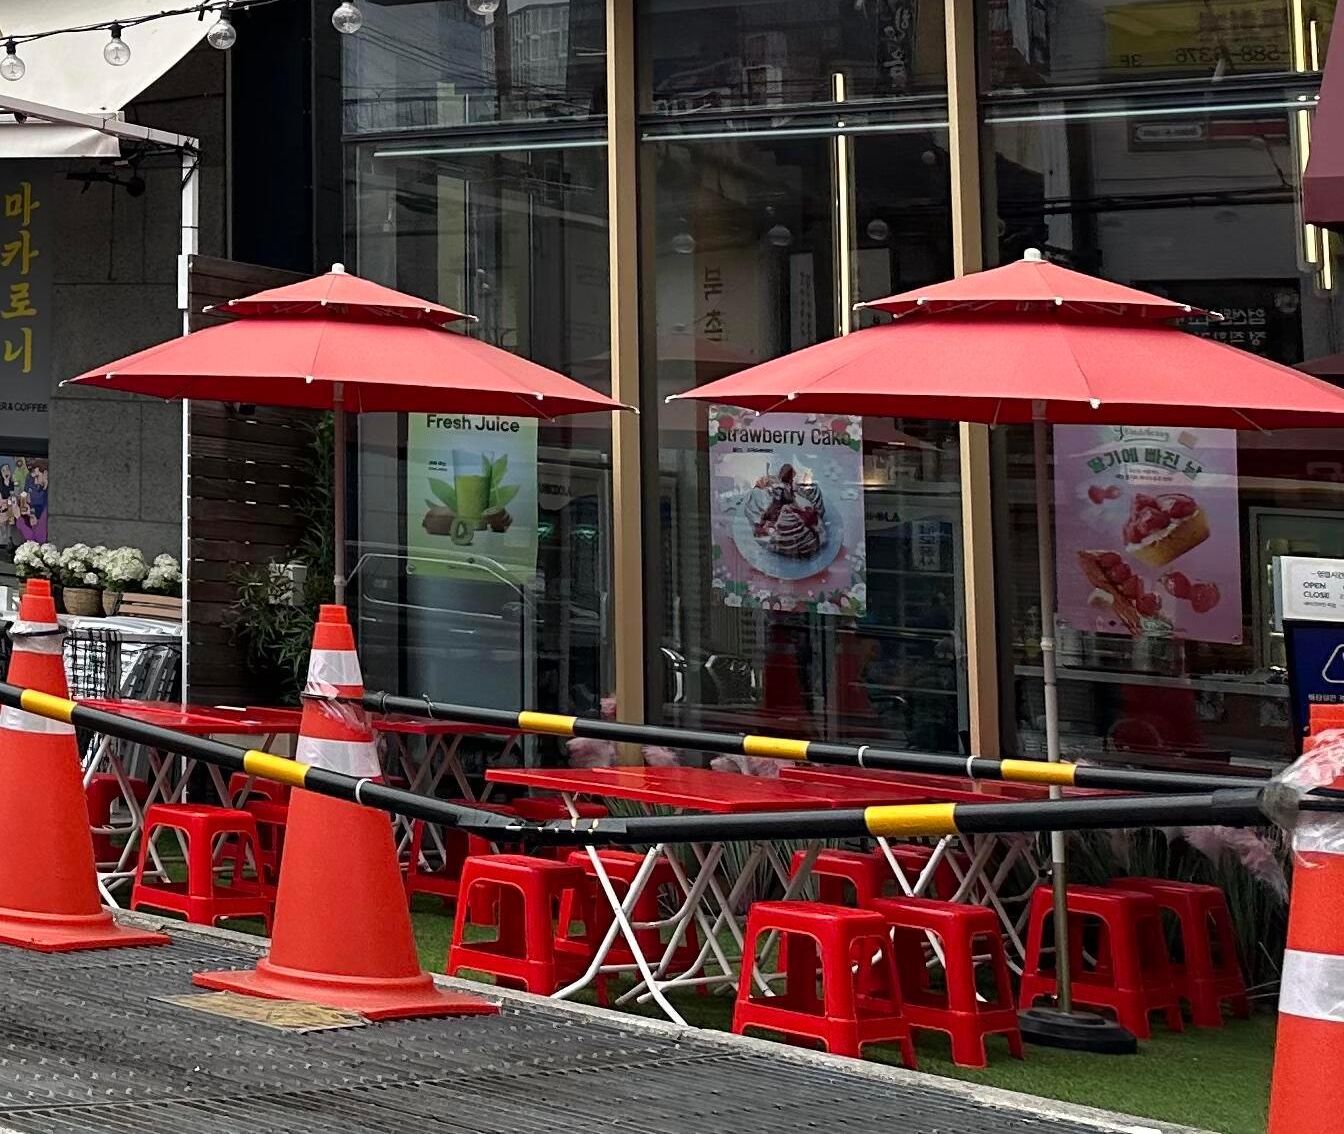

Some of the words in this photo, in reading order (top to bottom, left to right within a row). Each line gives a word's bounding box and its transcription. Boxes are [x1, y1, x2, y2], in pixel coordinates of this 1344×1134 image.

[0, 181, 41, 374] 마카로니
[14, 401, 49, 413] COFFEE
[426, 414, 471, 431] Fresh
[475, 416, 521, 433] Juice
[718, 427, 805, 446] Strawberry
[1088, 447, 1139, 474] 딸기에
[1144, 447, 1180, 470] 빠진
[1302, 581, 1327, 589] OPEN
[1303, 591, 1330, 599] CLOSE
